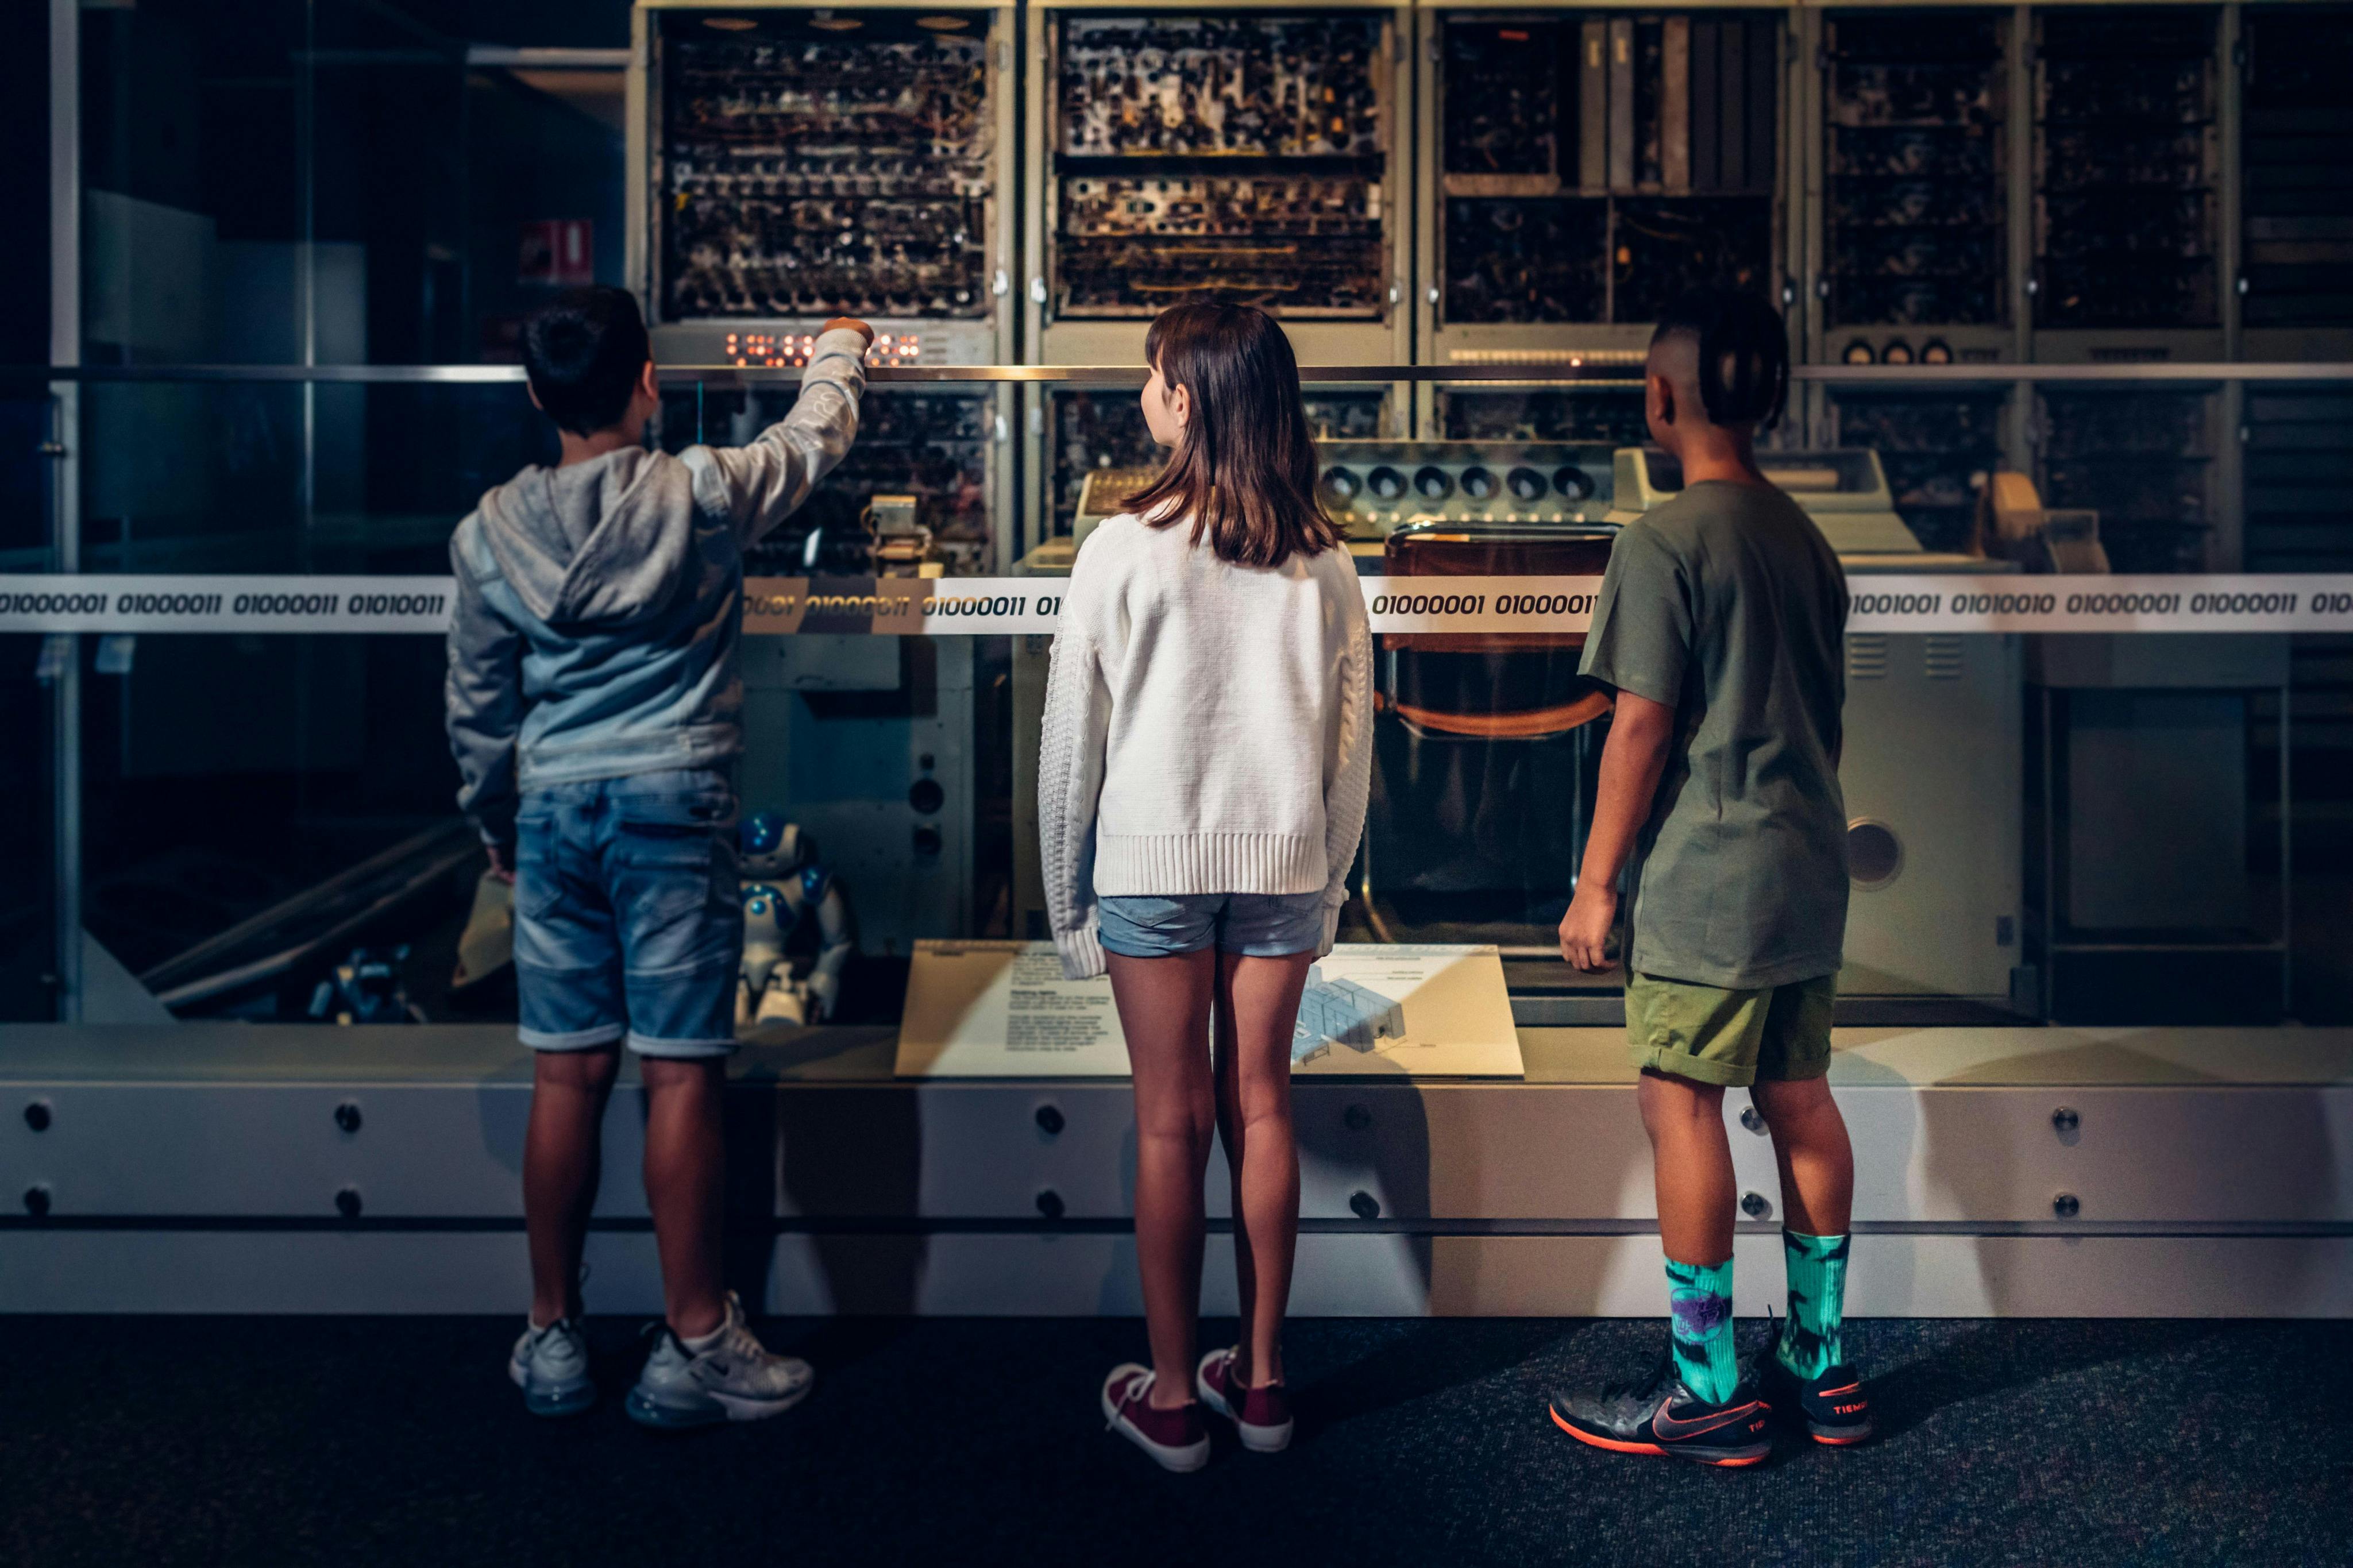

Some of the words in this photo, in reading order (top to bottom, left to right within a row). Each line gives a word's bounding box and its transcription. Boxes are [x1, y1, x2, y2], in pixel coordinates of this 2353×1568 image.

[0, 593, 108, 615] 01000001
[117, 593, 222, 615] 01000011
[233, 593, 339, 615] 01000011
[348, 594, 445, 615] 01010011
[921, 596, 1026, 616] 01000011
[1372, 595, 1484, 615] 01000001
[1853, 594, 1941, 615] 1001001
[1951, 594, 2055, 614] 01010010
[2066, 593, 2181, 614] 01000001
[2190, 593, 2297, 614] 01000011
